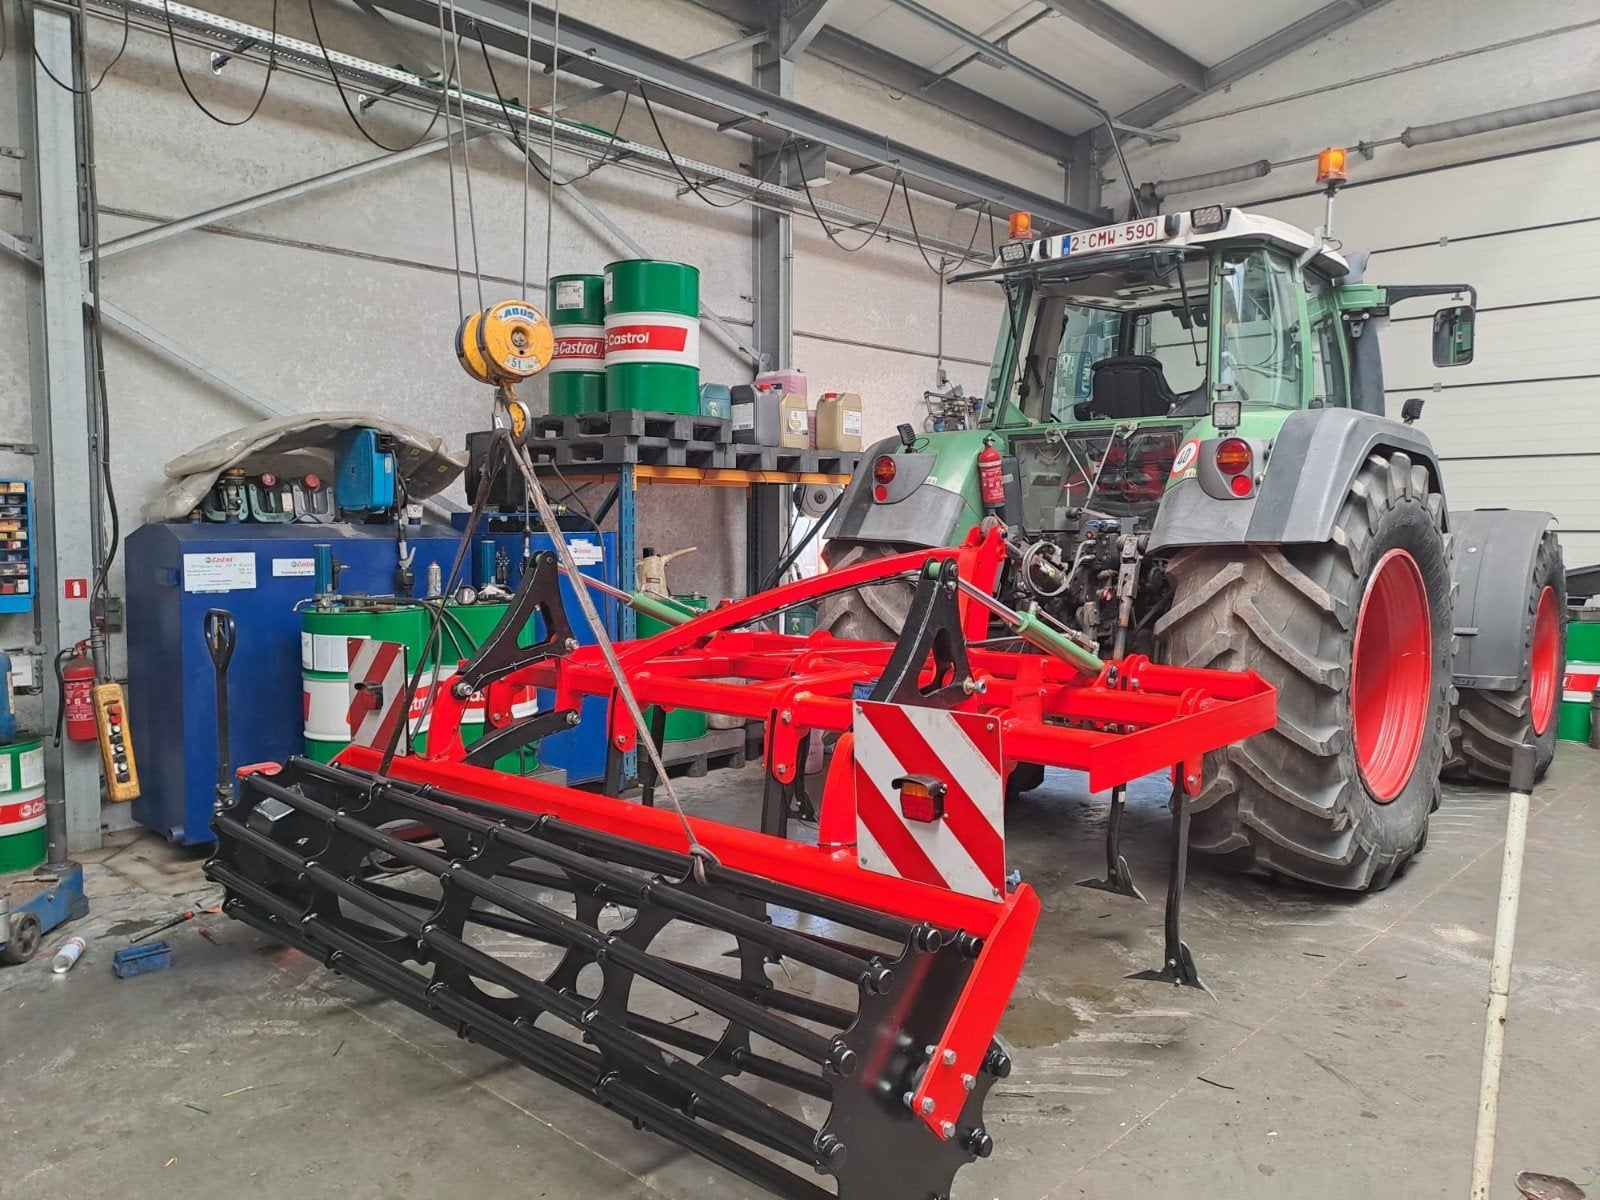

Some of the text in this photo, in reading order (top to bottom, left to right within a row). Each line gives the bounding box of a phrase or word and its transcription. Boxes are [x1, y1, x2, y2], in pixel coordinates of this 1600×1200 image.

[504, 307, 535, 320] ABUS
[608, 332, 650, 346] Castrol
[559, 341, 598, 355] Castrol
[1177, 447, 1191, 464] 40
